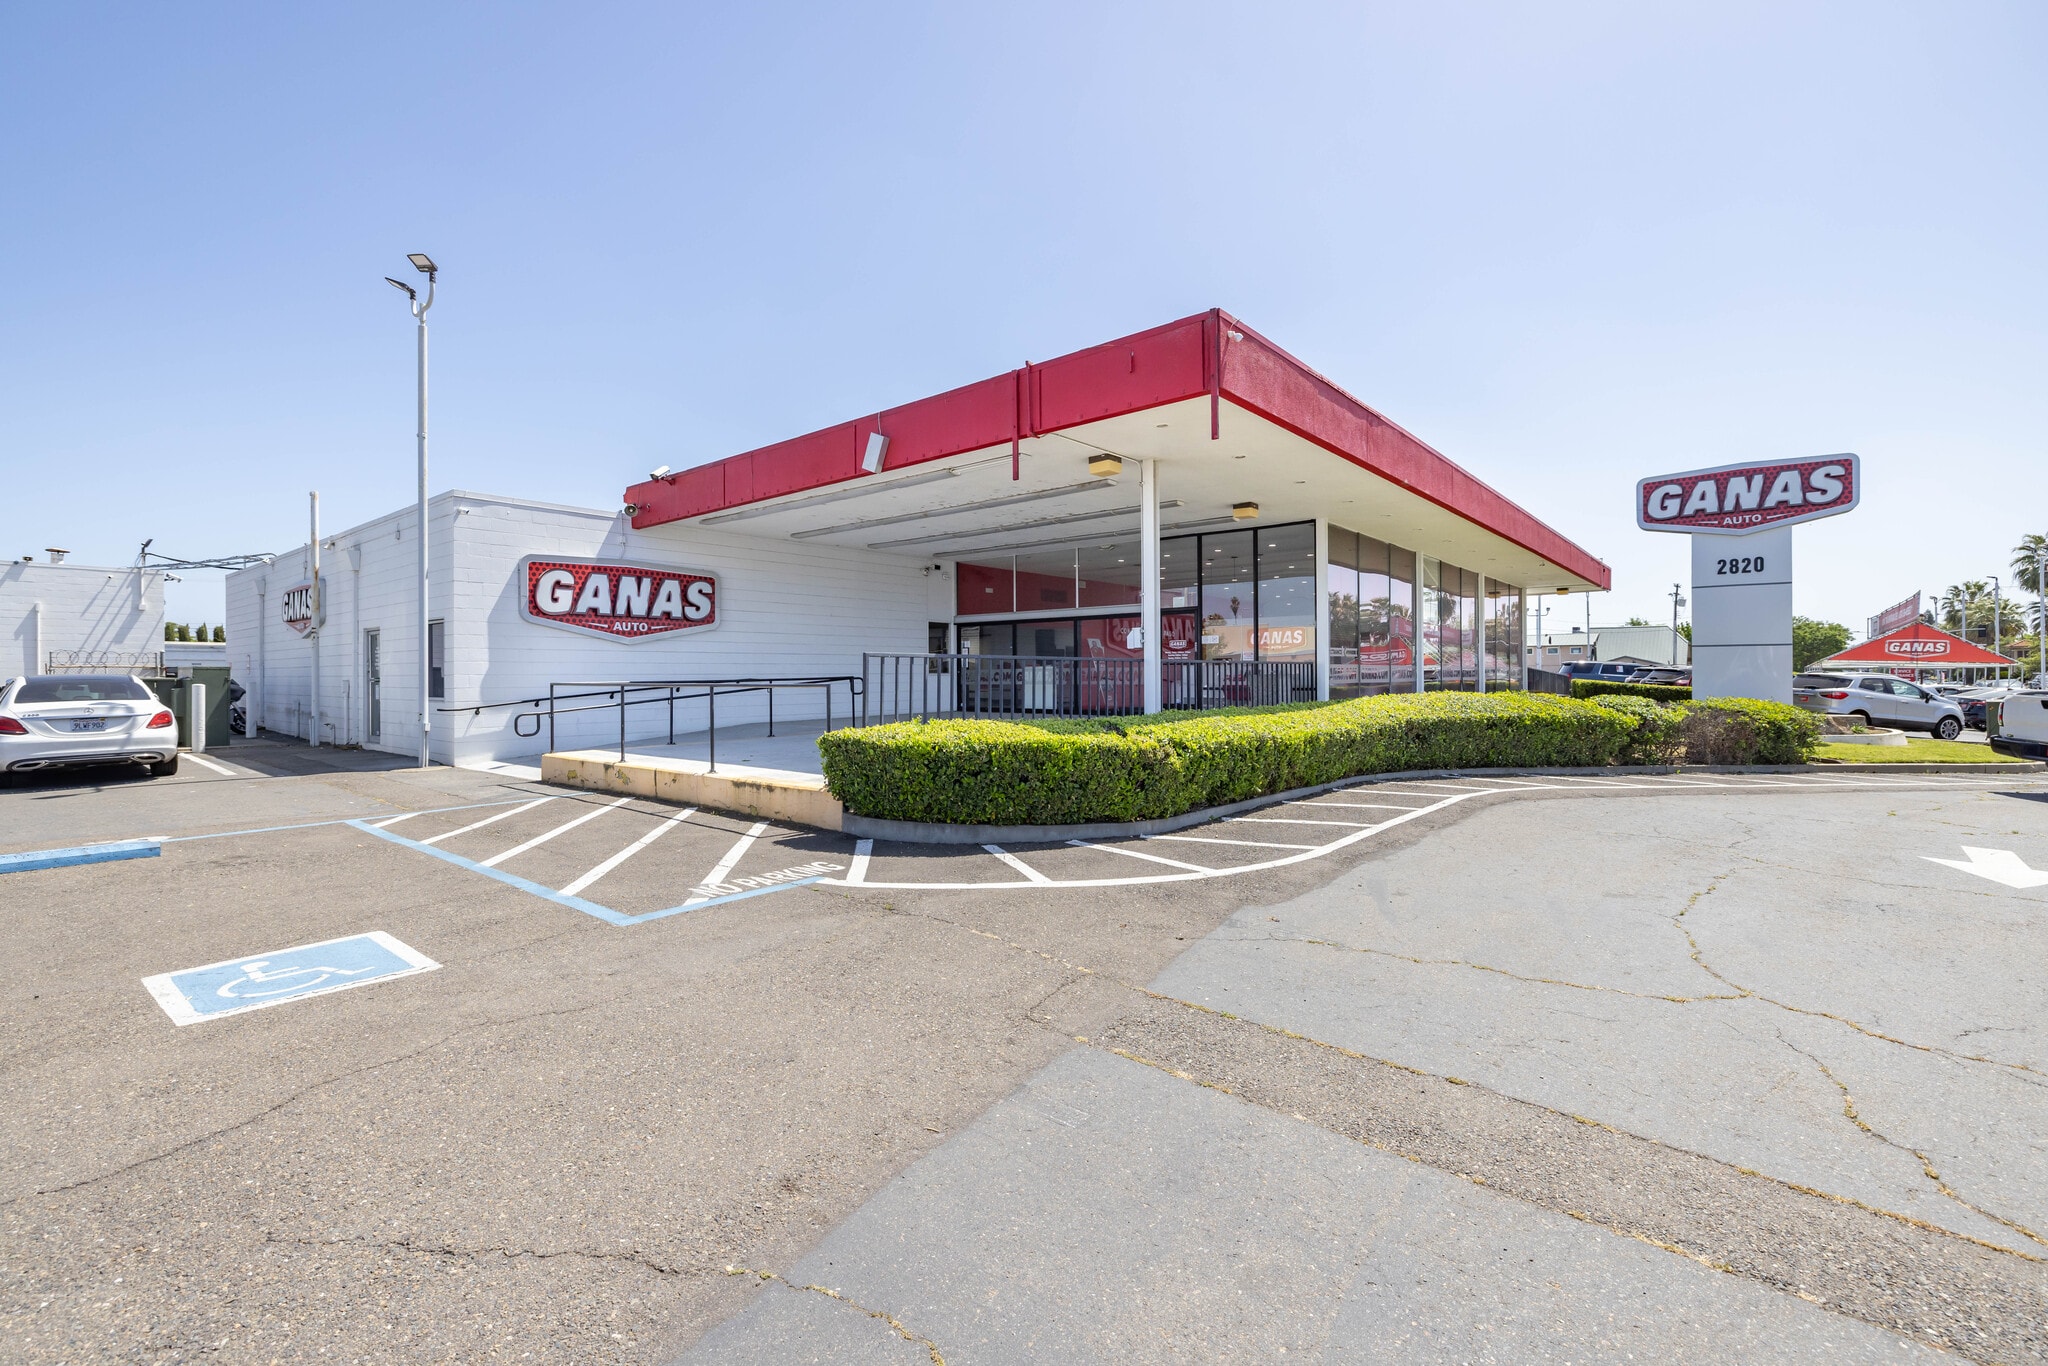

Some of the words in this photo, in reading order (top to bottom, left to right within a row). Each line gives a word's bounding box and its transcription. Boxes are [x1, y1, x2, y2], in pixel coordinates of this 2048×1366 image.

[1647, 464, 1845, 521] GANAS
[1723, 514, 1761, 526] AUTO
[1717, 556, 1765, 575] 2820
[283, 588, 312, 622] GANAS
[536, 569, 713, 621] GANAS
[613, 621, 648, 632] AUTO
[1889, 642, 1946, 653] GANAS
[732, 861, 846, 888] PARKING
